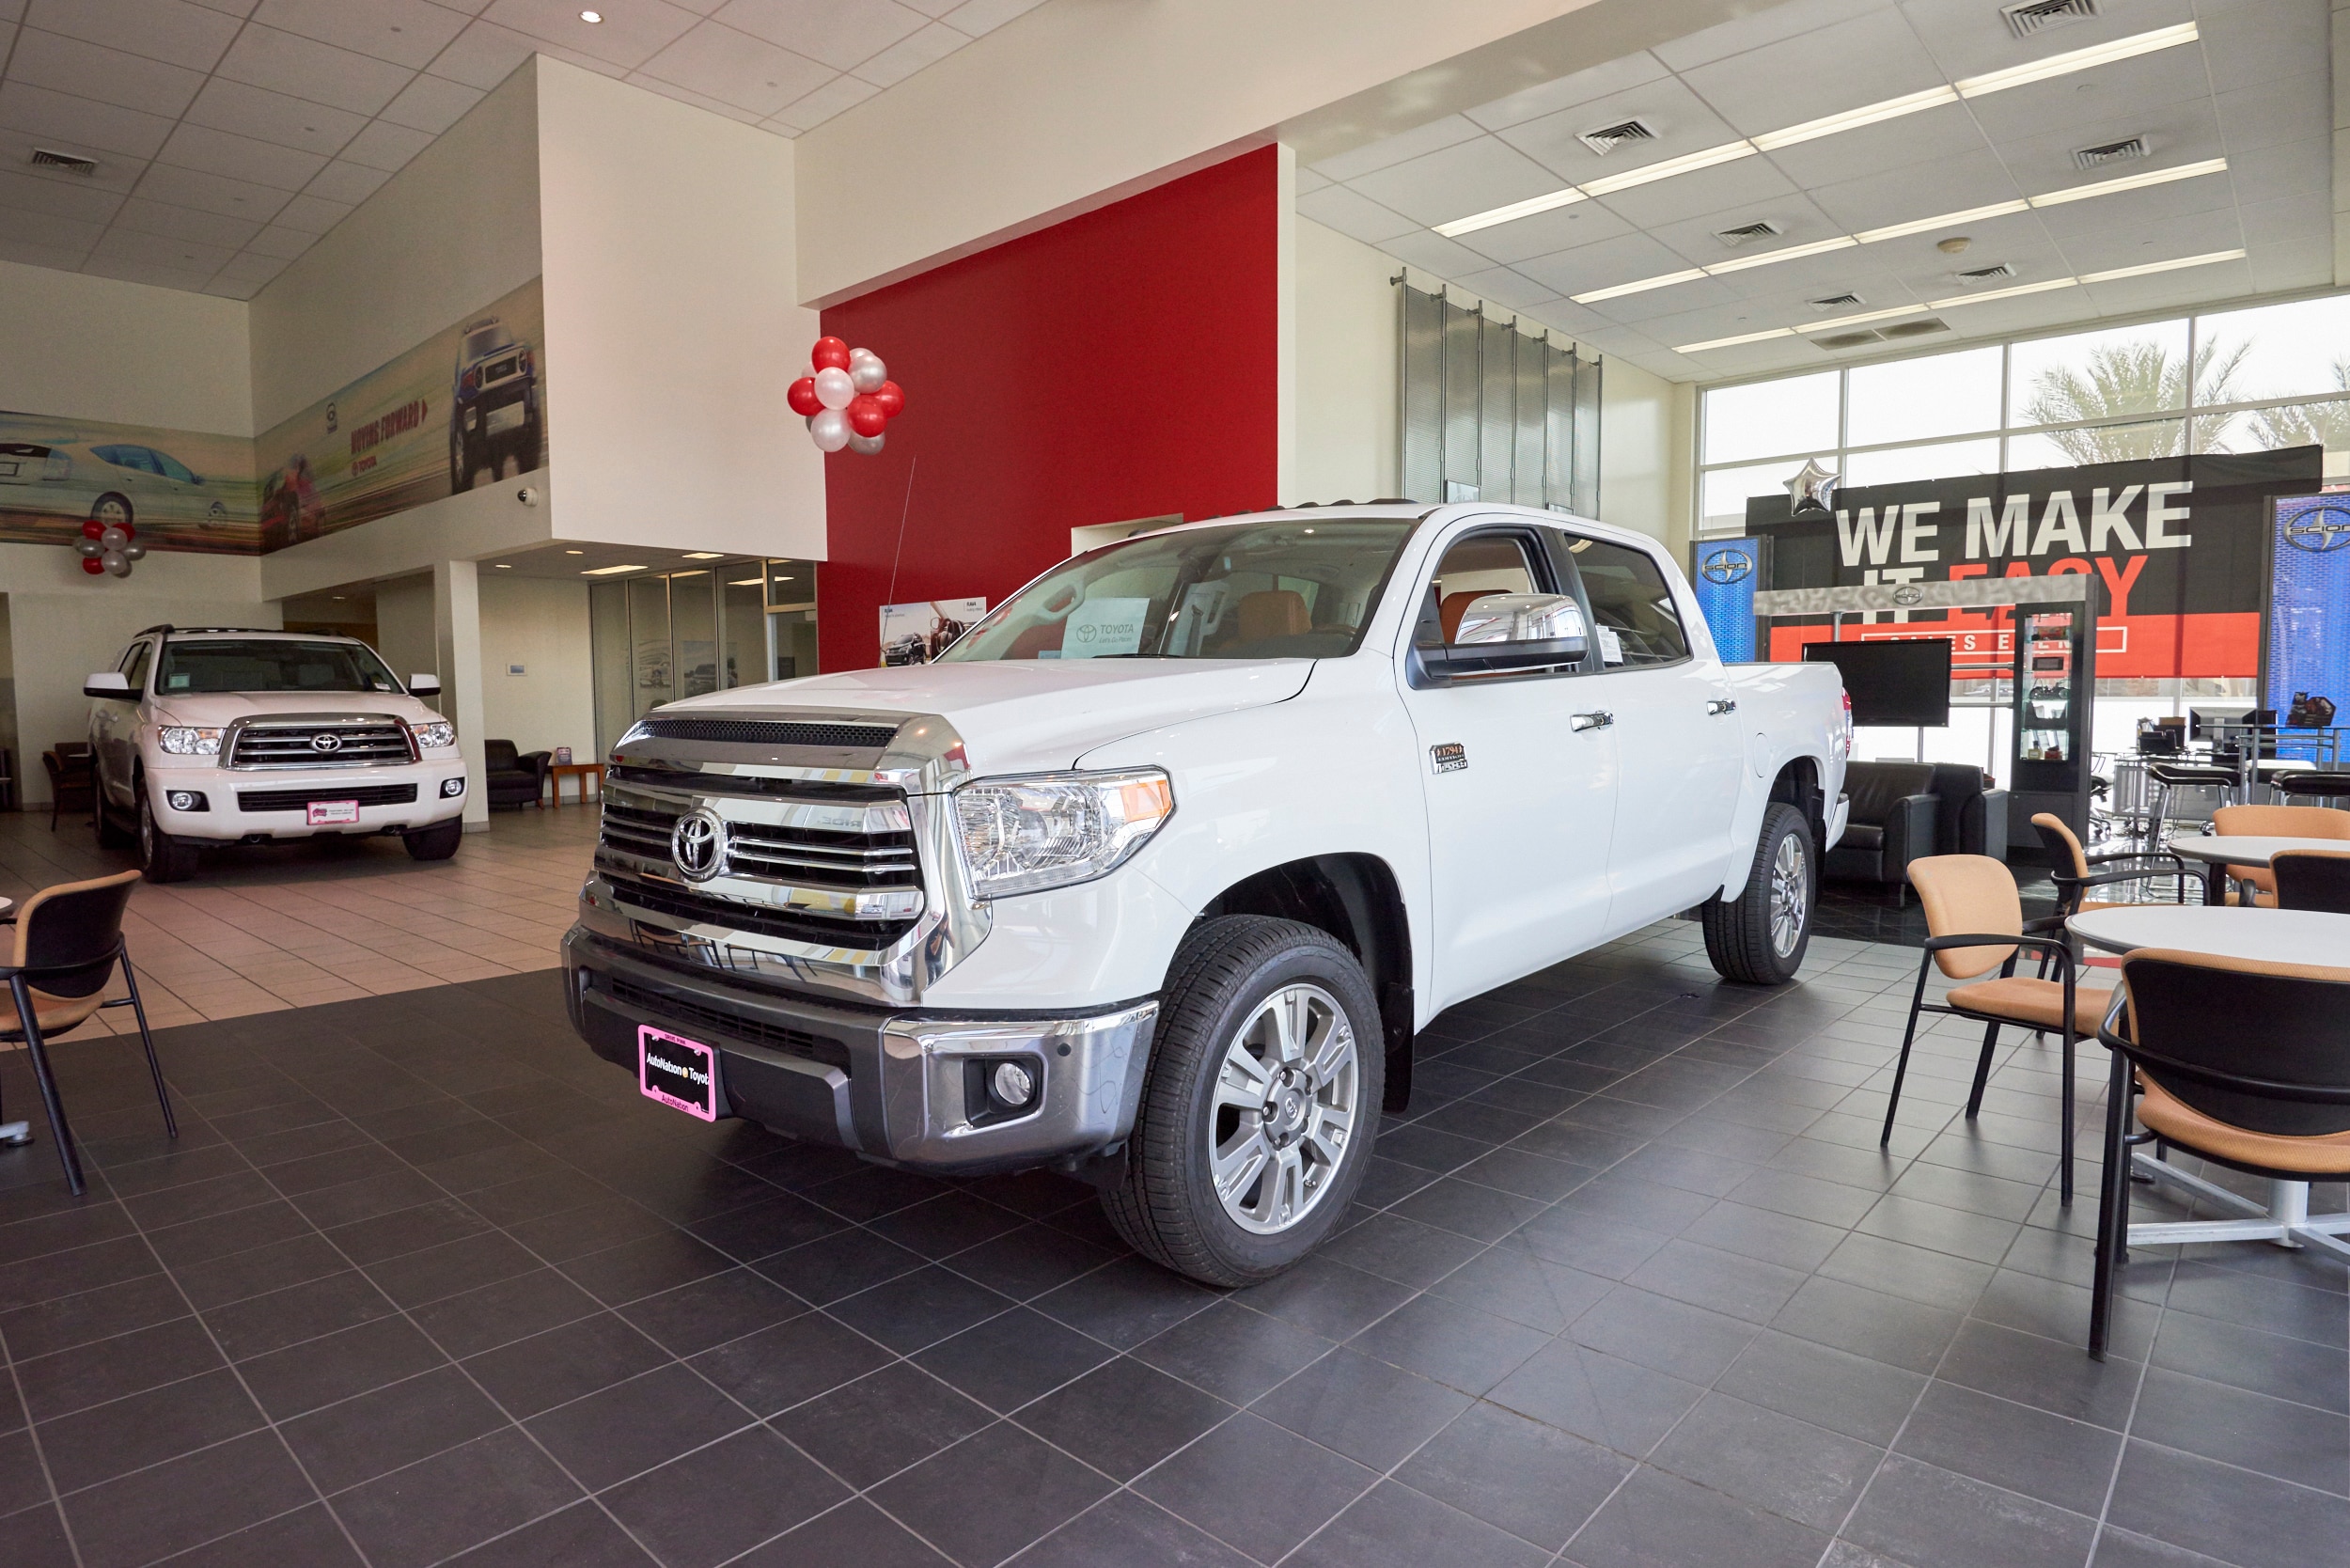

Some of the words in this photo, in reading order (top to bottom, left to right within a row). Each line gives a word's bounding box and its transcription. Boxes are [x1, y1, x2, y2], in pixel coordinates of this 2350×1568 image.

[351, 419, 379, 455] MOVING
[381, 400, 419, 442] FORWARD
[358, 455, 378, 473] TOYOTA
[1835, 501, 1940, 566] WE
[1966, 480, 2193, 558] MAKE
[1100, 623, 1134, 635] TOYOTA
[1441, 745, 1459, 757] 1794
[646, 1052, 682, 1076] AutoNation
[661, 1094, 689, 1112] AutoNation
